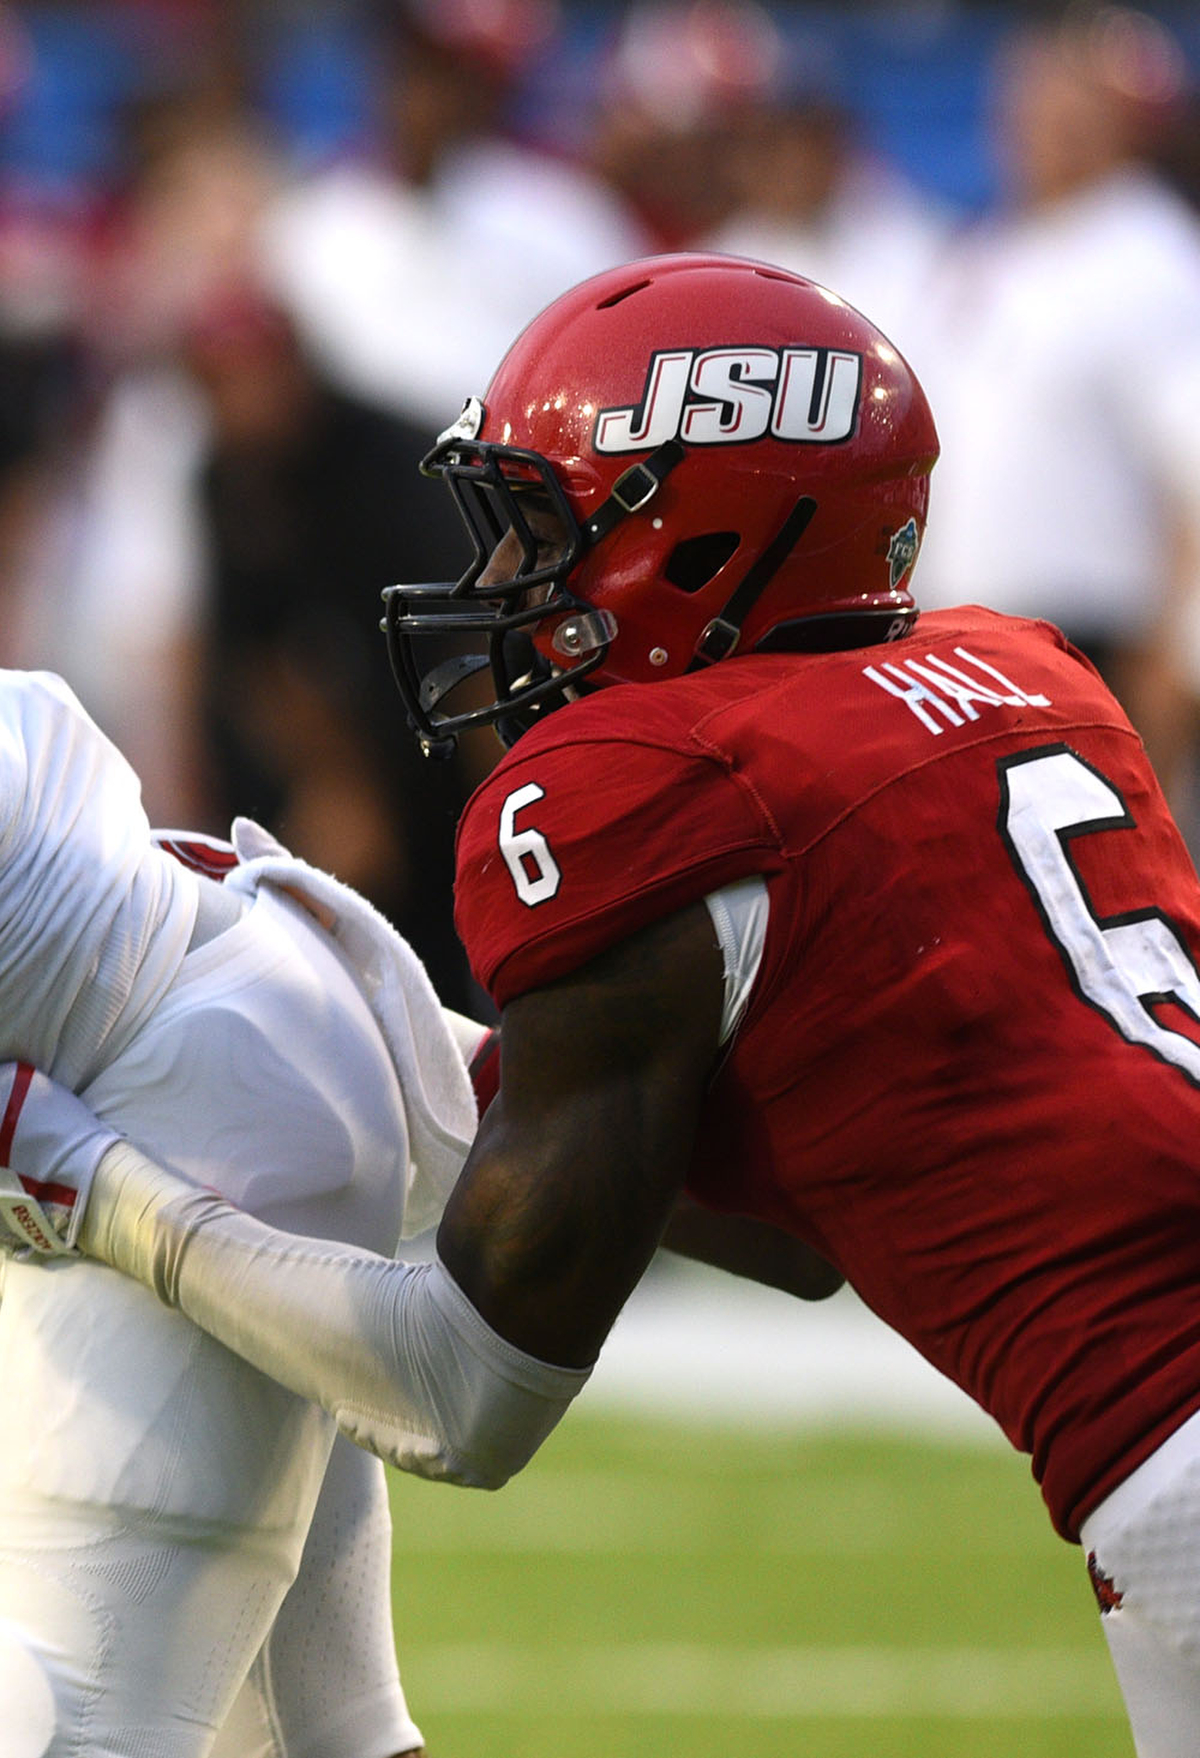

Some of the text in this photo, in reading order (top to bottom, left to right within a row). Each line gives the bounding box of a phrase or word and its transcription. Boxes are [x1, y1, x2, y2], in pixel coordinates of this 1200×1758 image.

[592, 346, 863, 455] JSU
[862, 646, 1052, 735] HALL
[498, 781, 563, 909] 6
[995, 741, 1200, 1090] 6
